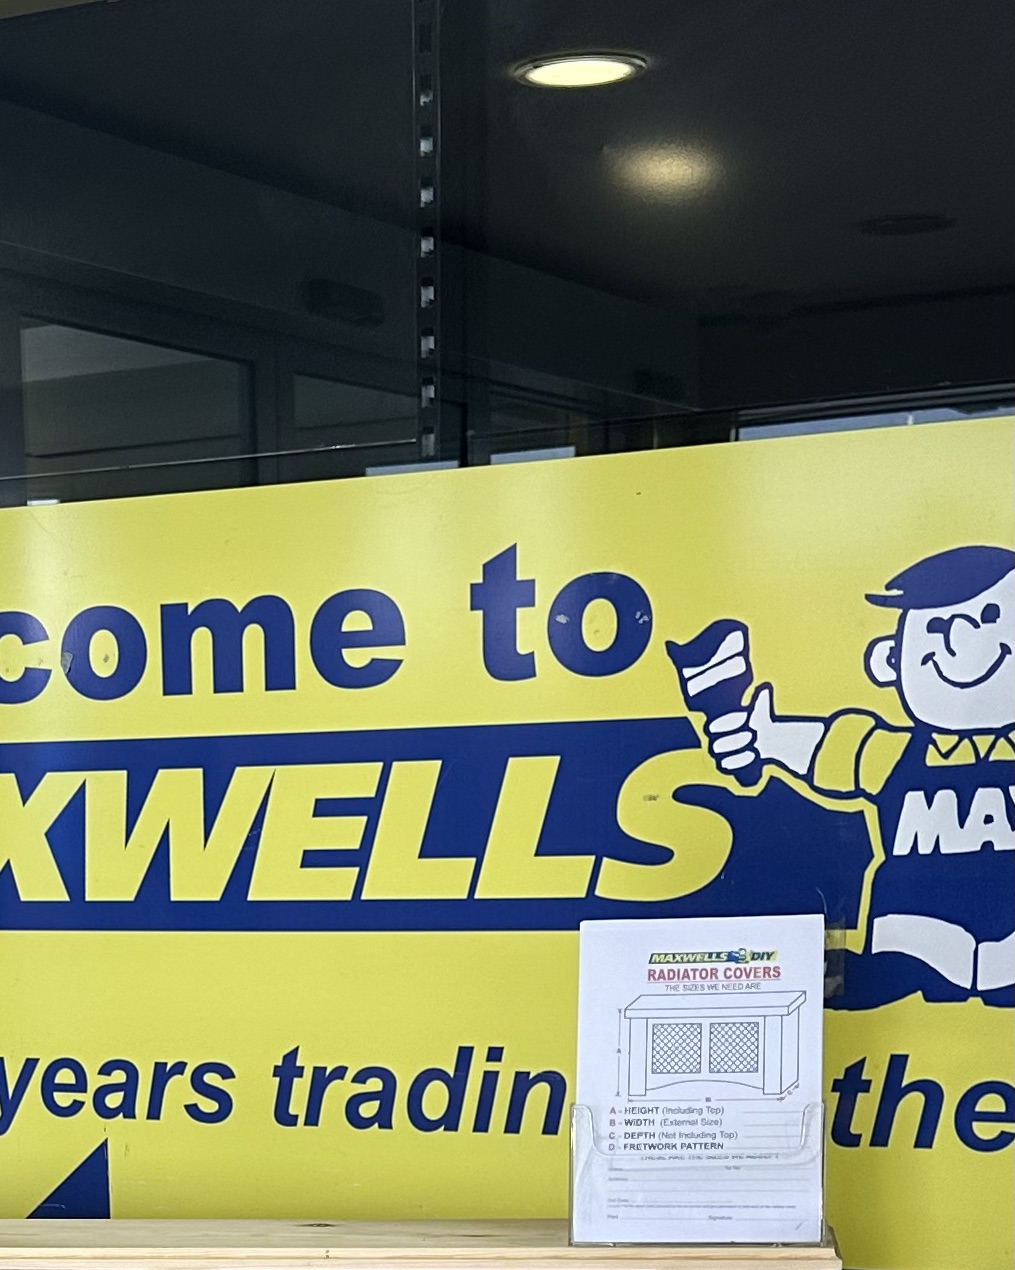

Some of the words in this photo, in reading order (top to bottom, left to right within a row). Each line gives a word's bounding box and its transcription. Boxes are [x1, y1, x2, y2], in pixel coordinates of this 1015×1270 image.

[470, 543, 652, 681] to
[893, 786, 1015, 855] MA
[651, 951, 727, 964] MAXWELLS
[750, 951, 775, 962] DIY
[647, 968, 719, 982] RADIATOR
[723, 966, 781, 980] COVERS
[665, 984, 680, 992] THE
[682, 984, 705, 992] SIZES
[707, 983, 719, 991] WE
[722, 983, 744, 991] NEED
[745, 982, 761, 991] ARE
[272, 1045, 568, 1136] tradin
[609, 1107, 617, 1115] A
[624, 1106, 659, 1115] HEIGHT
[661, 1105, 703, 1117] (Including
[706, 1105, 725, 1117] Top)
[624, 1118, 655, 1127] WIDTH
[660, 1117, 698, 1127] (External
[700, 1117, 723, 1127] Size)
[623, 1131, 655, 1140] DEPTH
[657, 1130, 676, 1141] (Not
[678, 1130, 716, 1141] Including
[718, 1130, 738, 1141] Top)
[623, 1142, 677, 1151] FRETWORK
[681, 1142, 724, 1151] PATTERN
